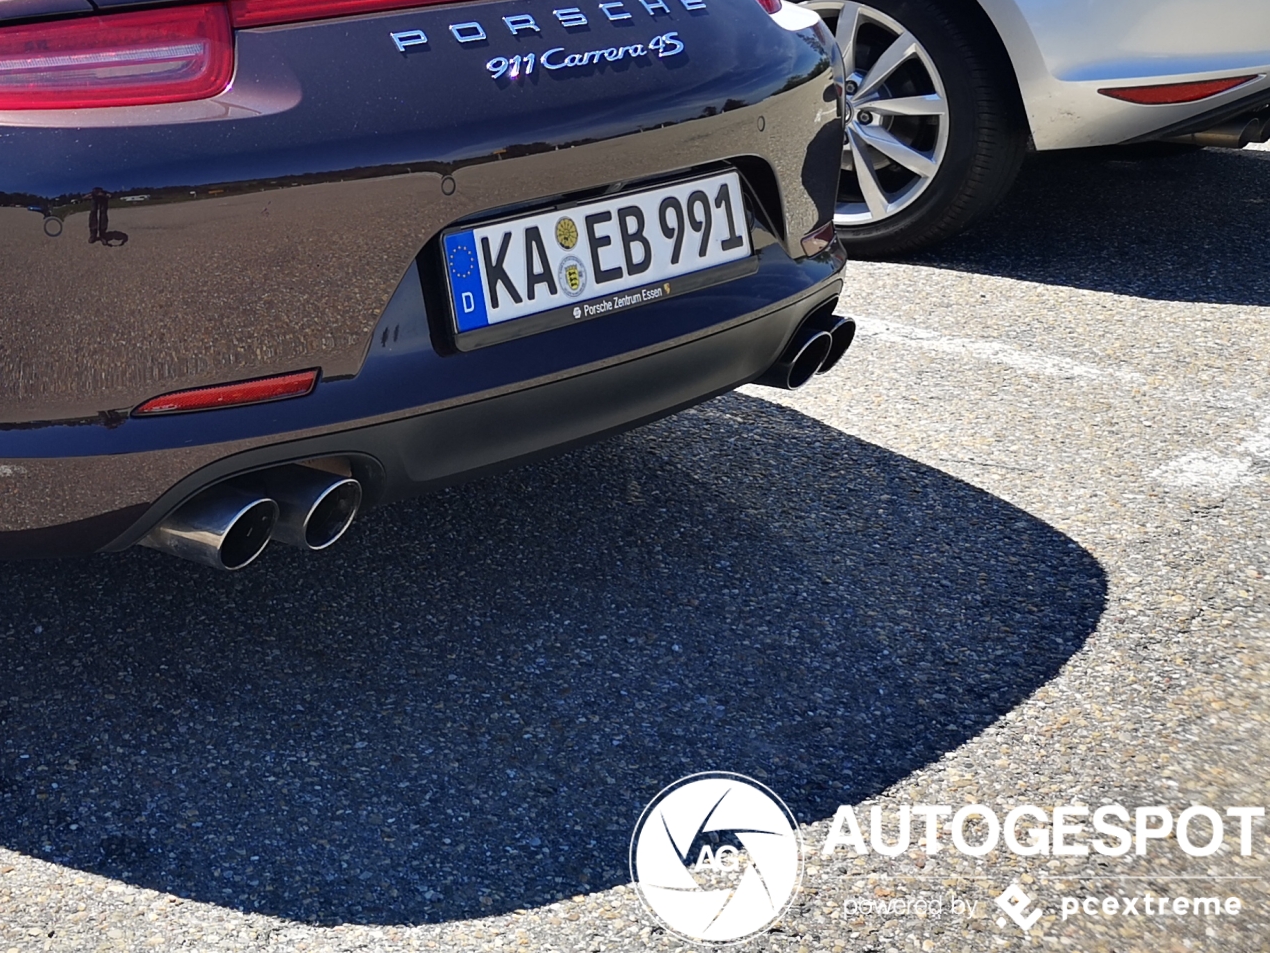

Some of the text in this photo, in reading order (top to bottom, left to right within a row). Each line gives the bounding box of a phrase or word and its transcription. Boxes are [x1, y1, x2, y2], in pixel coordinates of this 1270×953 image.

[487, 32, 685, 80] 911 Carrera 4S
[480, 226, 558, 309] KA
[585, 205, 652, 284] EB
[658, 183, 744, 265] 991
[461, 291, 475, 313] D
[583, 287, 663, 317] Porsche Zentrum Essen
